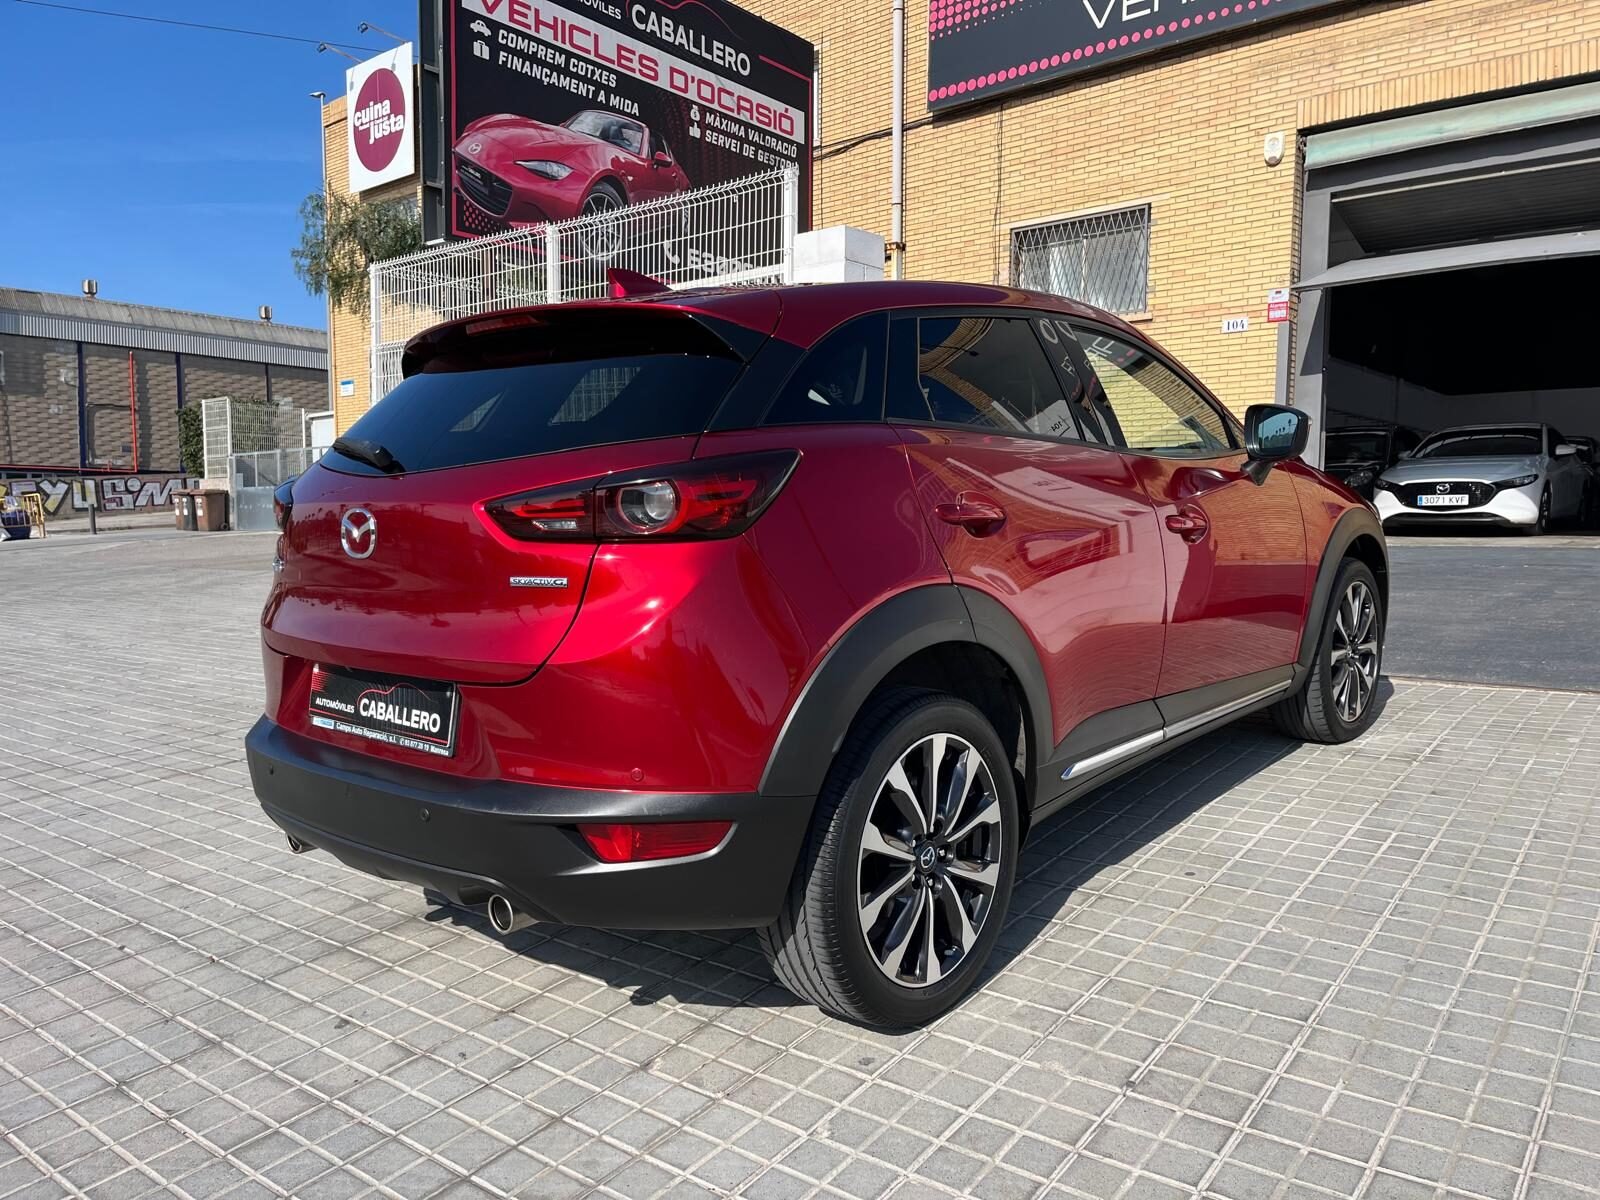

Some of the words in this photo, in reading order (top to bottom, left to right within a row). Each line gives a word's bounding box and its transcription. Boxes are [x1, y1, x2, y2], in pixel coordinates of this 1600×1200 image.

[498, 29, 566, 68] COMPREM
[569, 57, 617, 88] COTXES
[631, 4, 751, 77] CABALLERO
[480, 0, 660, 82] VEHICLES
[669, 65, 794, 137] D'OCASIÓ
[498, 50, 596, 100] FINANÇAMENT
[597, 89, 606, 104] A
[609, 93, 640, 117] MIDA
[354, 99, 391, 127] cuina
[368, 113, 404, 145] justa
[705, 111, 746, 138] MÀXIMA
[748, 128, 798, 158] VALORACIÓ
[705, 130, 741, 153] SERVEI
[742, 144, 755, 159] DE
[1227, 319, 1245, 331] 104
[1423, 496, 1446, 505] 3071
[1448, 496, 1467, 504] KVF
[315, 696, 355, 714] AUTOMÓVILES
[359, 697, 441, 733] CABALLERO
